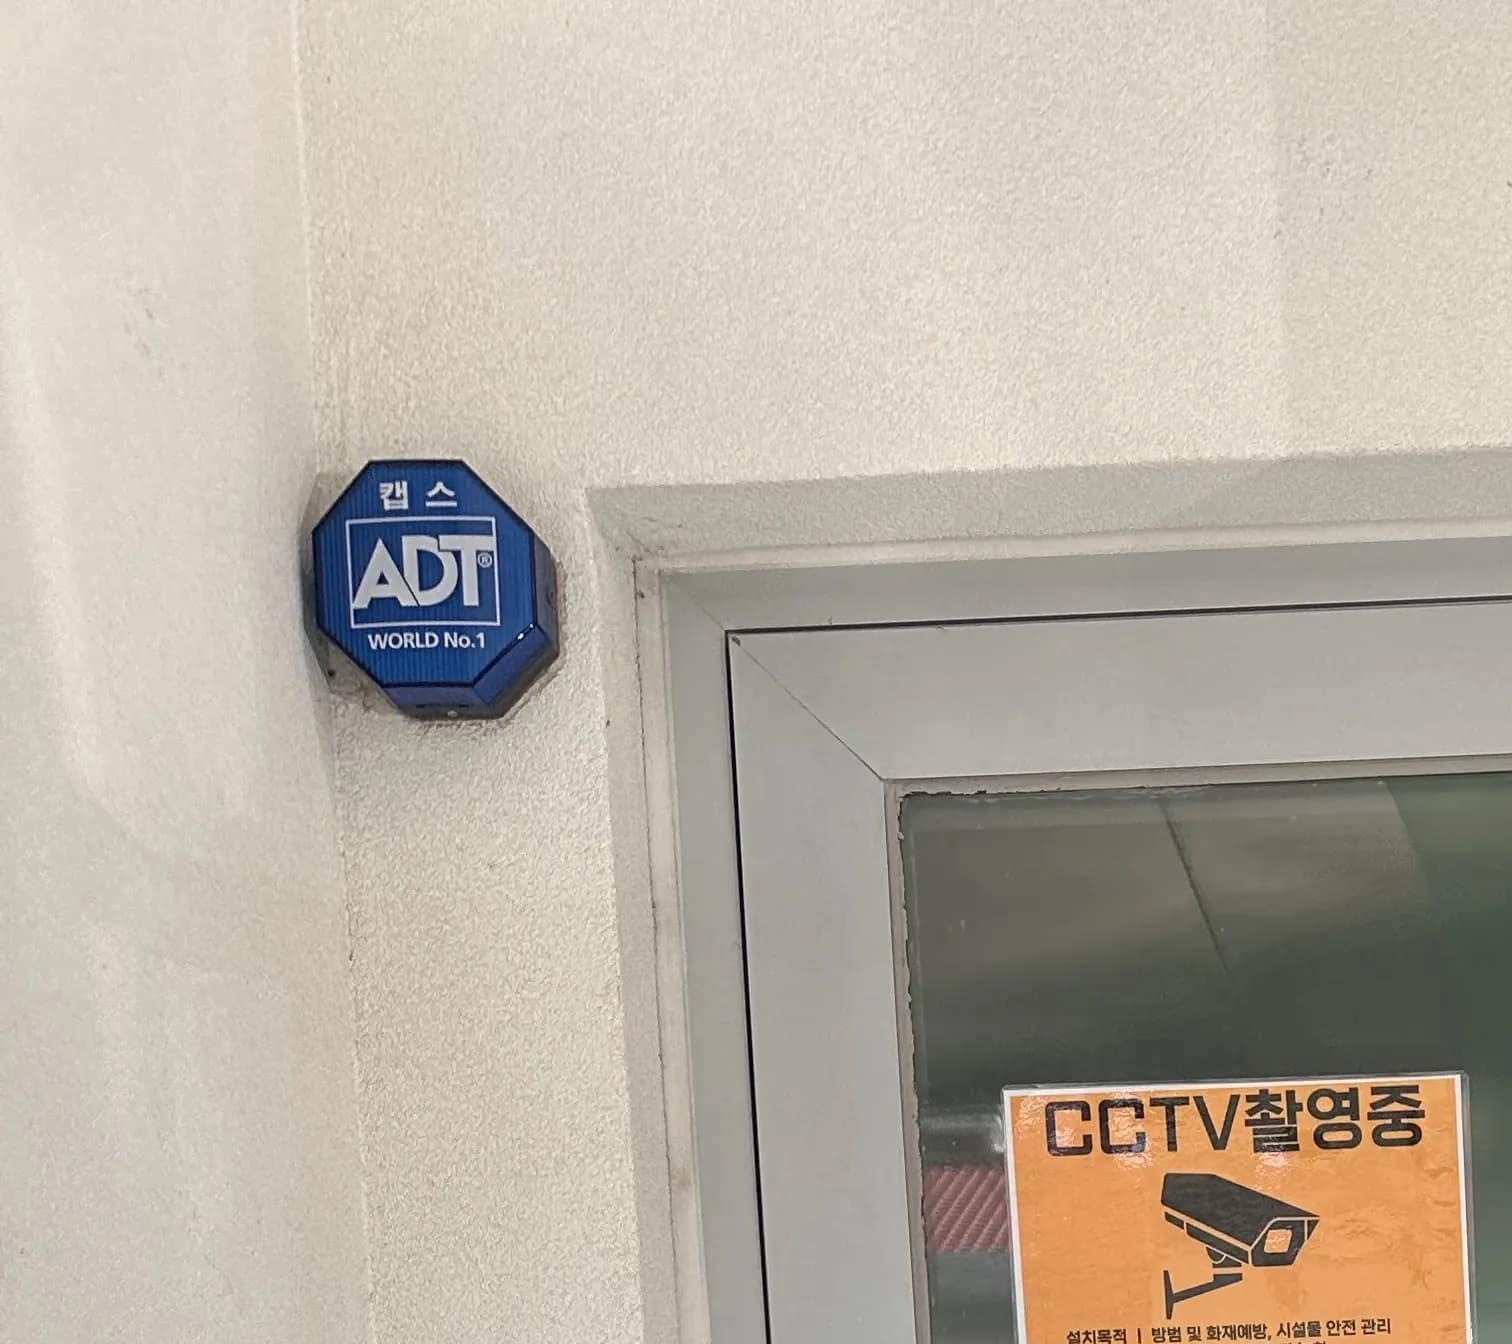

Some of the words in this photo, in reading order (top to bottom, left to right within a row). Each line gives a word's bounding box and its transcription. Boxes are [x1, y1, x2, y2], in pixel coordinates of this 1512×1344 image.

[367, 632, 439, 650] WORLD
[443, 631, 486, 649] No.1
[1151, 1326, 1182, 1344] 방범
[1186, 1325, 1202, 1343] 및
[1206, 1322, 1272, 1342] 화재예방,
[1276, 1320, 1322, 1339] 시설물
[1326, 1318, 1357, 1337] 안전
[1360, 1317, 1392, 1335] 관리
